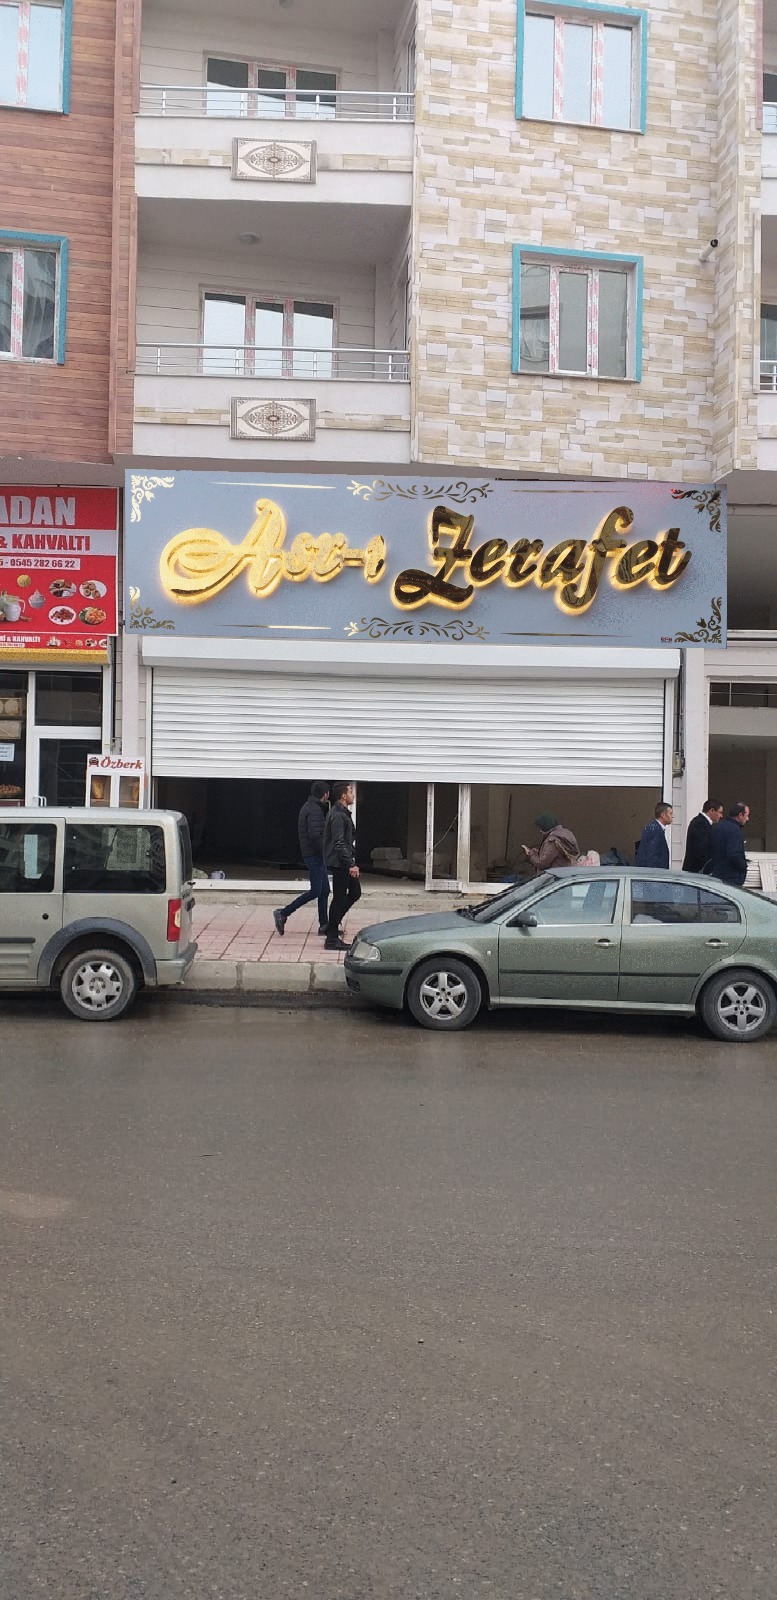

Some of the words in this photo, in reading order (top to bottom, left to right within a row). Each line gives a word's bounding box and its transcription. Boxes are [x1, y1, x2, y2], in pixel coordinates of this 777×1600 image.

[12, 534, 90, 551] KAHVALTI
[393, 506, 691, 607] Zerafet
[101, 757, 143, 769] Özberk
